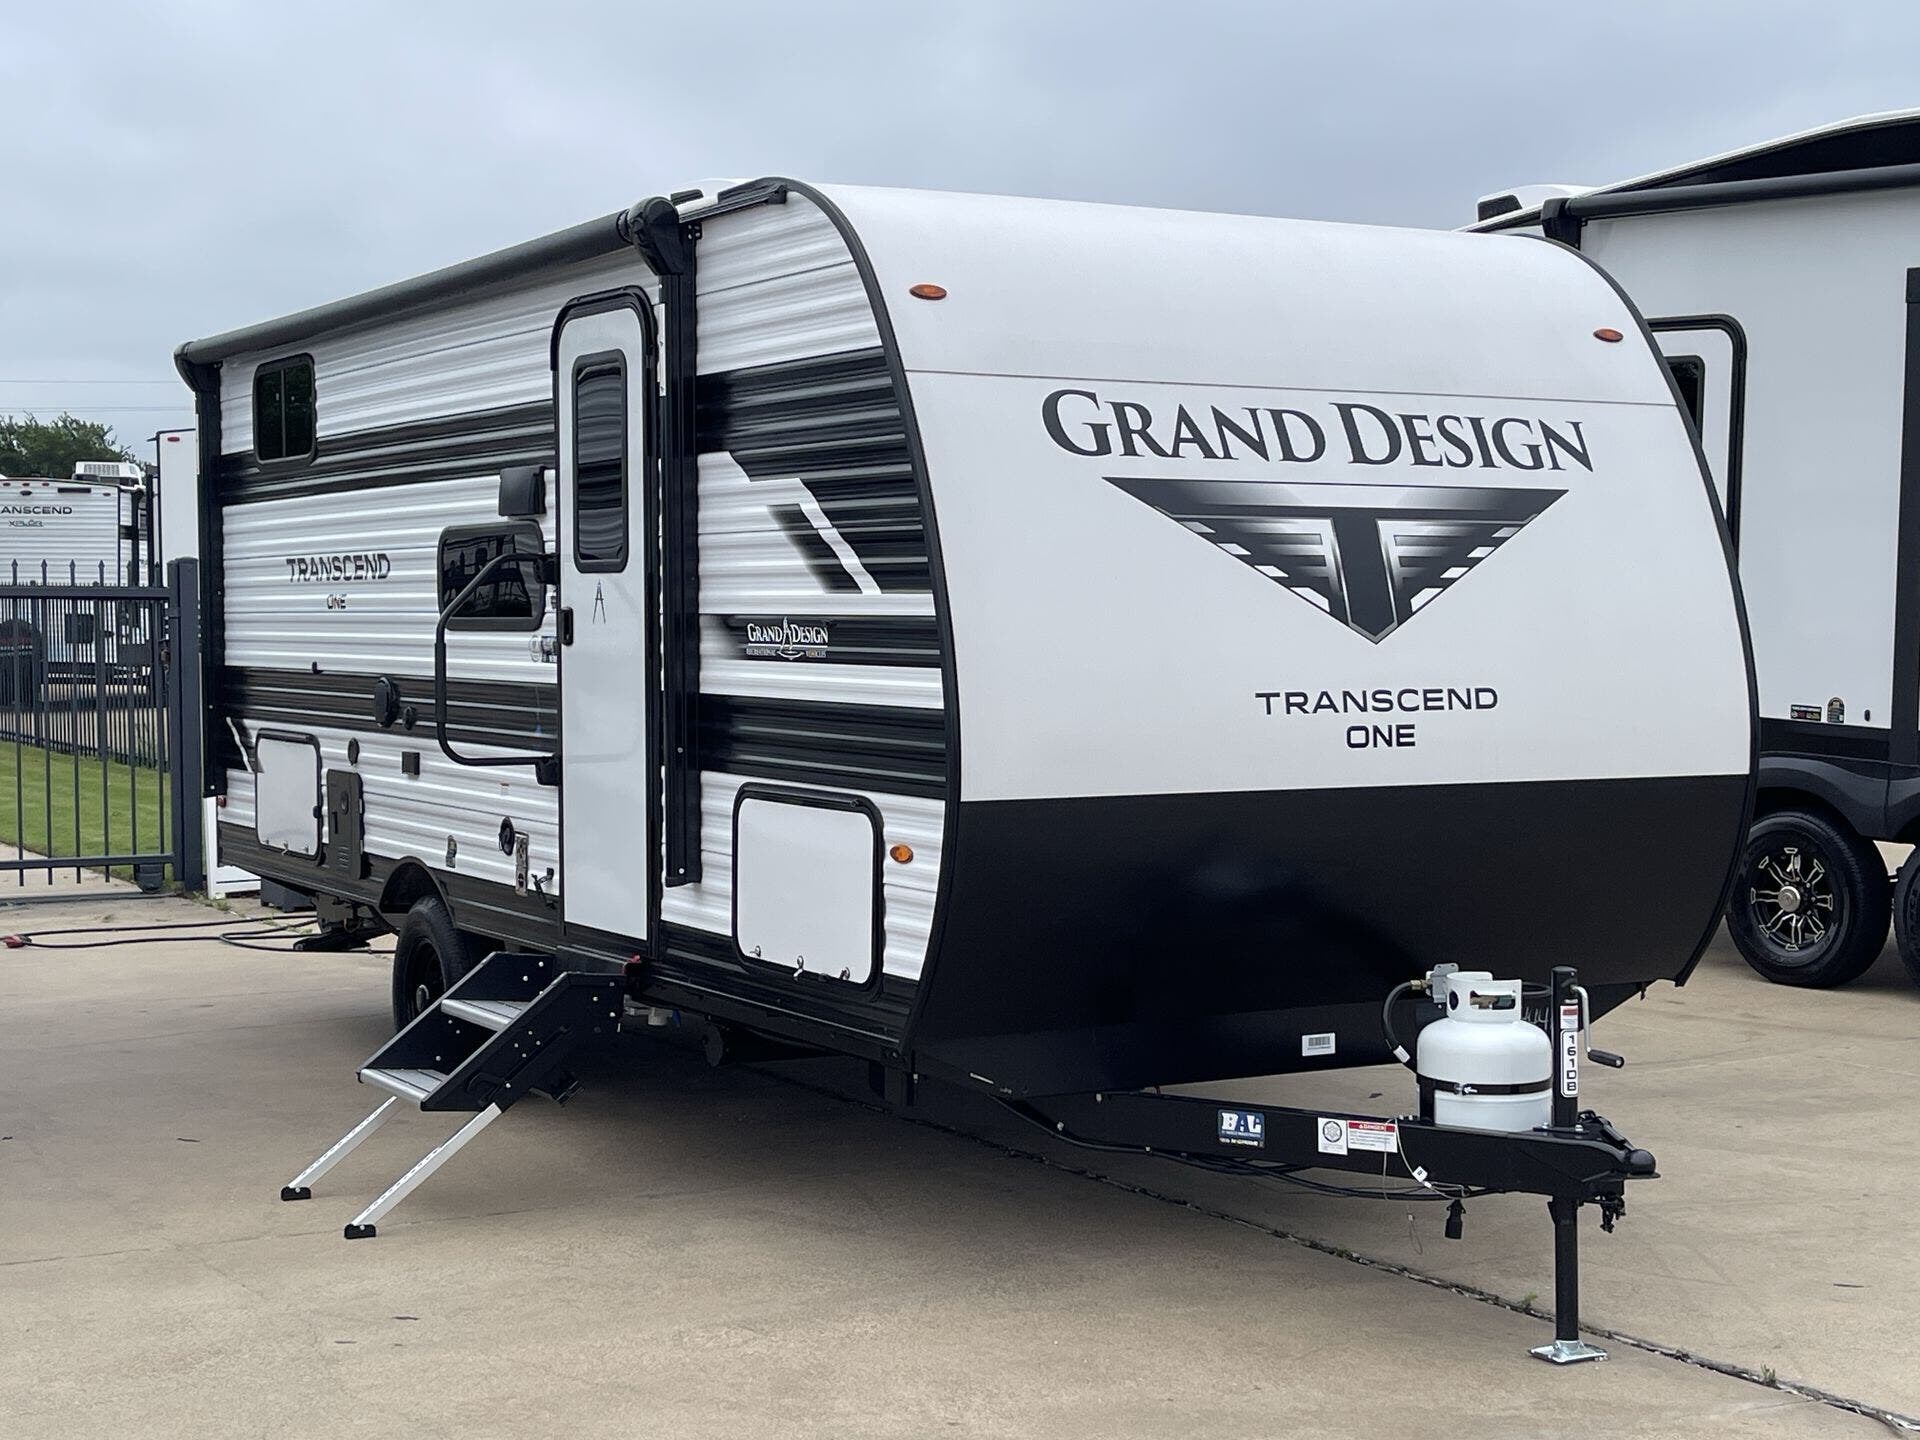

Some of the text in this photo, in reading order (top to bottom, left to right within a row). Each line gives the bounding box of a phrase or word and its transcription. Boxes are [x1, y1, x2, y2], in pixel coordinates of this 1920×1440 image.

[1042, 389, 1594, 473] GRAND DESIGN
[286, 553, 391, 582] TRANSCEND
[326, 593, 347, 609] ONE
[747, 623, 829, 643] GRAND DESIGN
[1255, 687, 1499, 716] TRANSCEND
[1346, 724, 1416, 749] ONE
[1221, 1112, 1262, 1134] BAL
